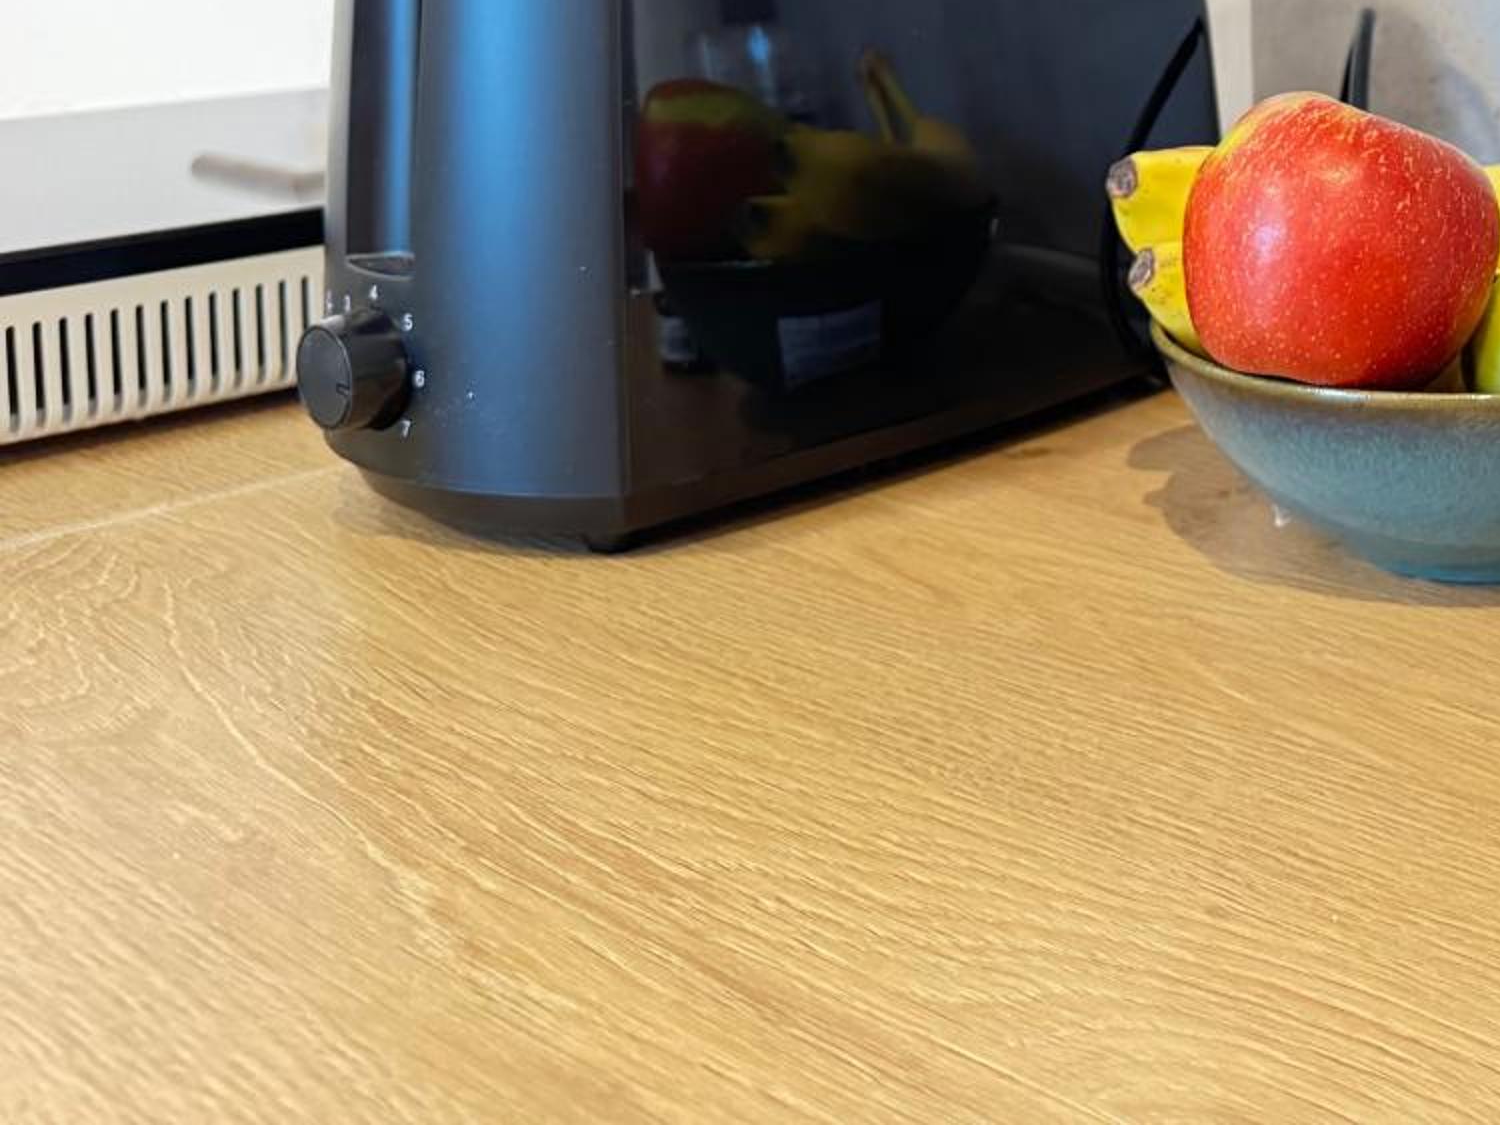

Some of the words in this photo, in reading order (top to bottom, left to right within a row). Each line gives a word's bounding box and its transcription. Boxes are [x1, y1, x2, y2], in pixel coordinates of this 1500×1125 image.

[369, 284, 379, 300] 4
[403, 313, 413, 331] 5
[415, 370, 425, 388] 6
[403, 420, 413, 437] 7
